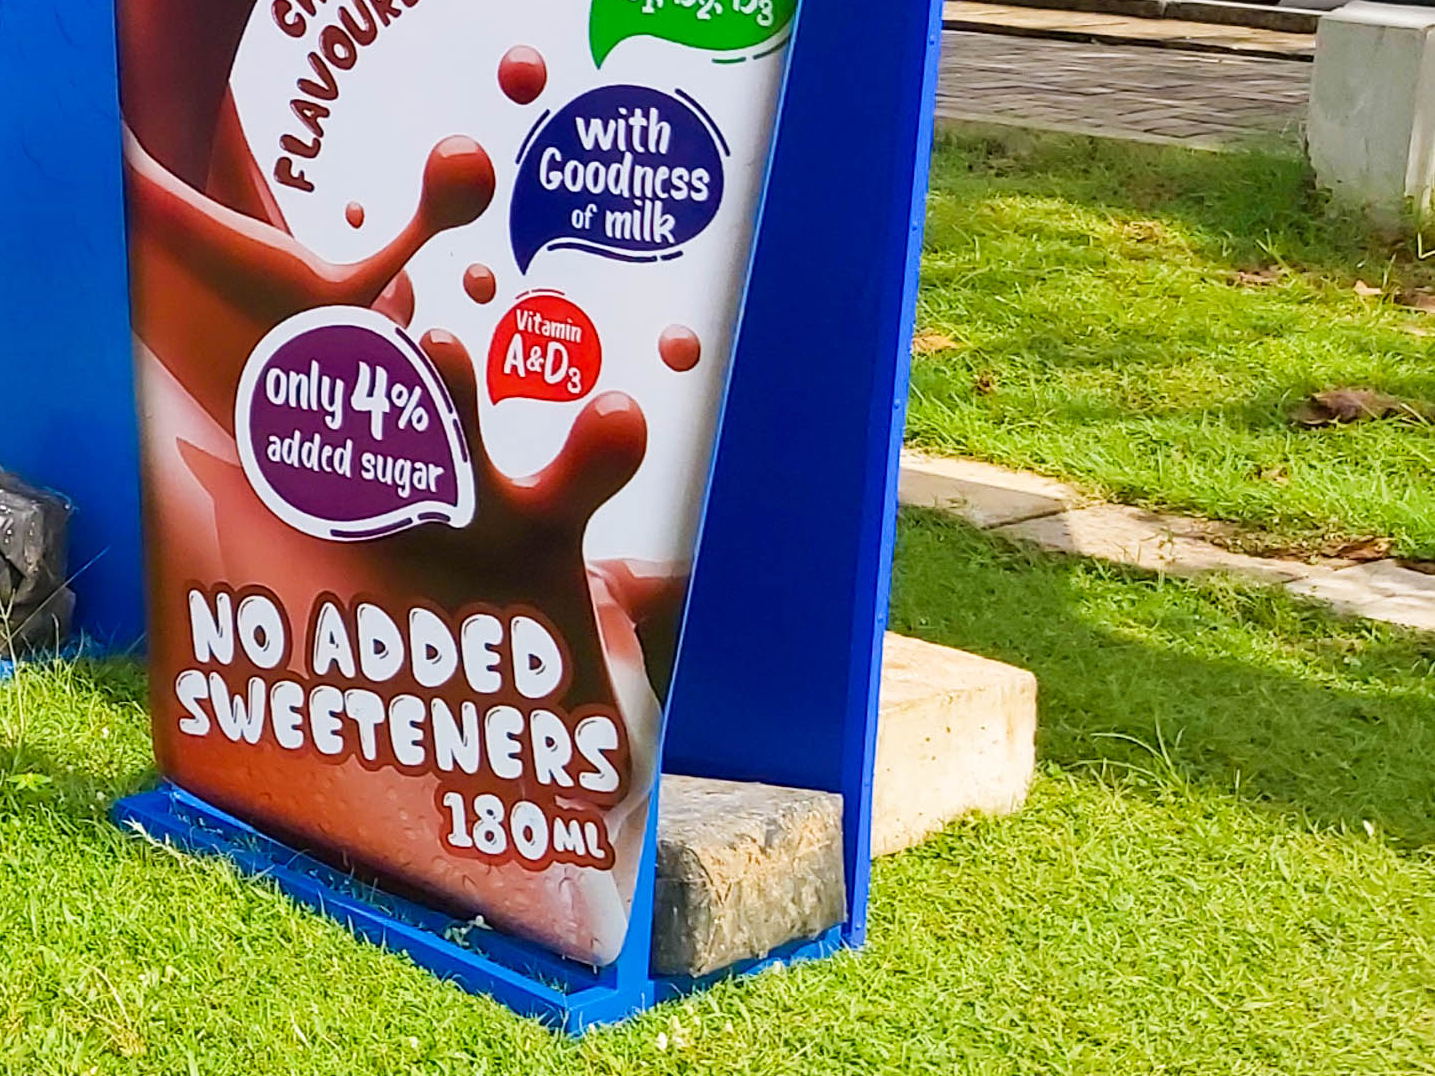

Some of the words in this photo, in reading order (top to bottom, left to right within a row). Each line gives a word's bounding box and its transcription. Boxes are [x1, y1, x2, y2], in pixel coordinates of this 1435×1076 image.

[576, 108, 671, 156] with
[539, 147, 710, 202] Goodness
[571, 205, 596, 231] of
[605, 201, 676, 245] milk
[516, 309, 582, 343] Vitamin
[504, 339, 583, 394] A&D3
[266, 361, 343, 426] only
[351, 362, 429, 440] 4%
[267, 432, 351, 479] added
[361, 449, 444, 499] sugar
[188, 590, 285, 668] NO
[312, 602, 564, 699] ADDED
[175, 670, 619, 792] SWEETENERS
[442, 791, 605, 860] 180ML
